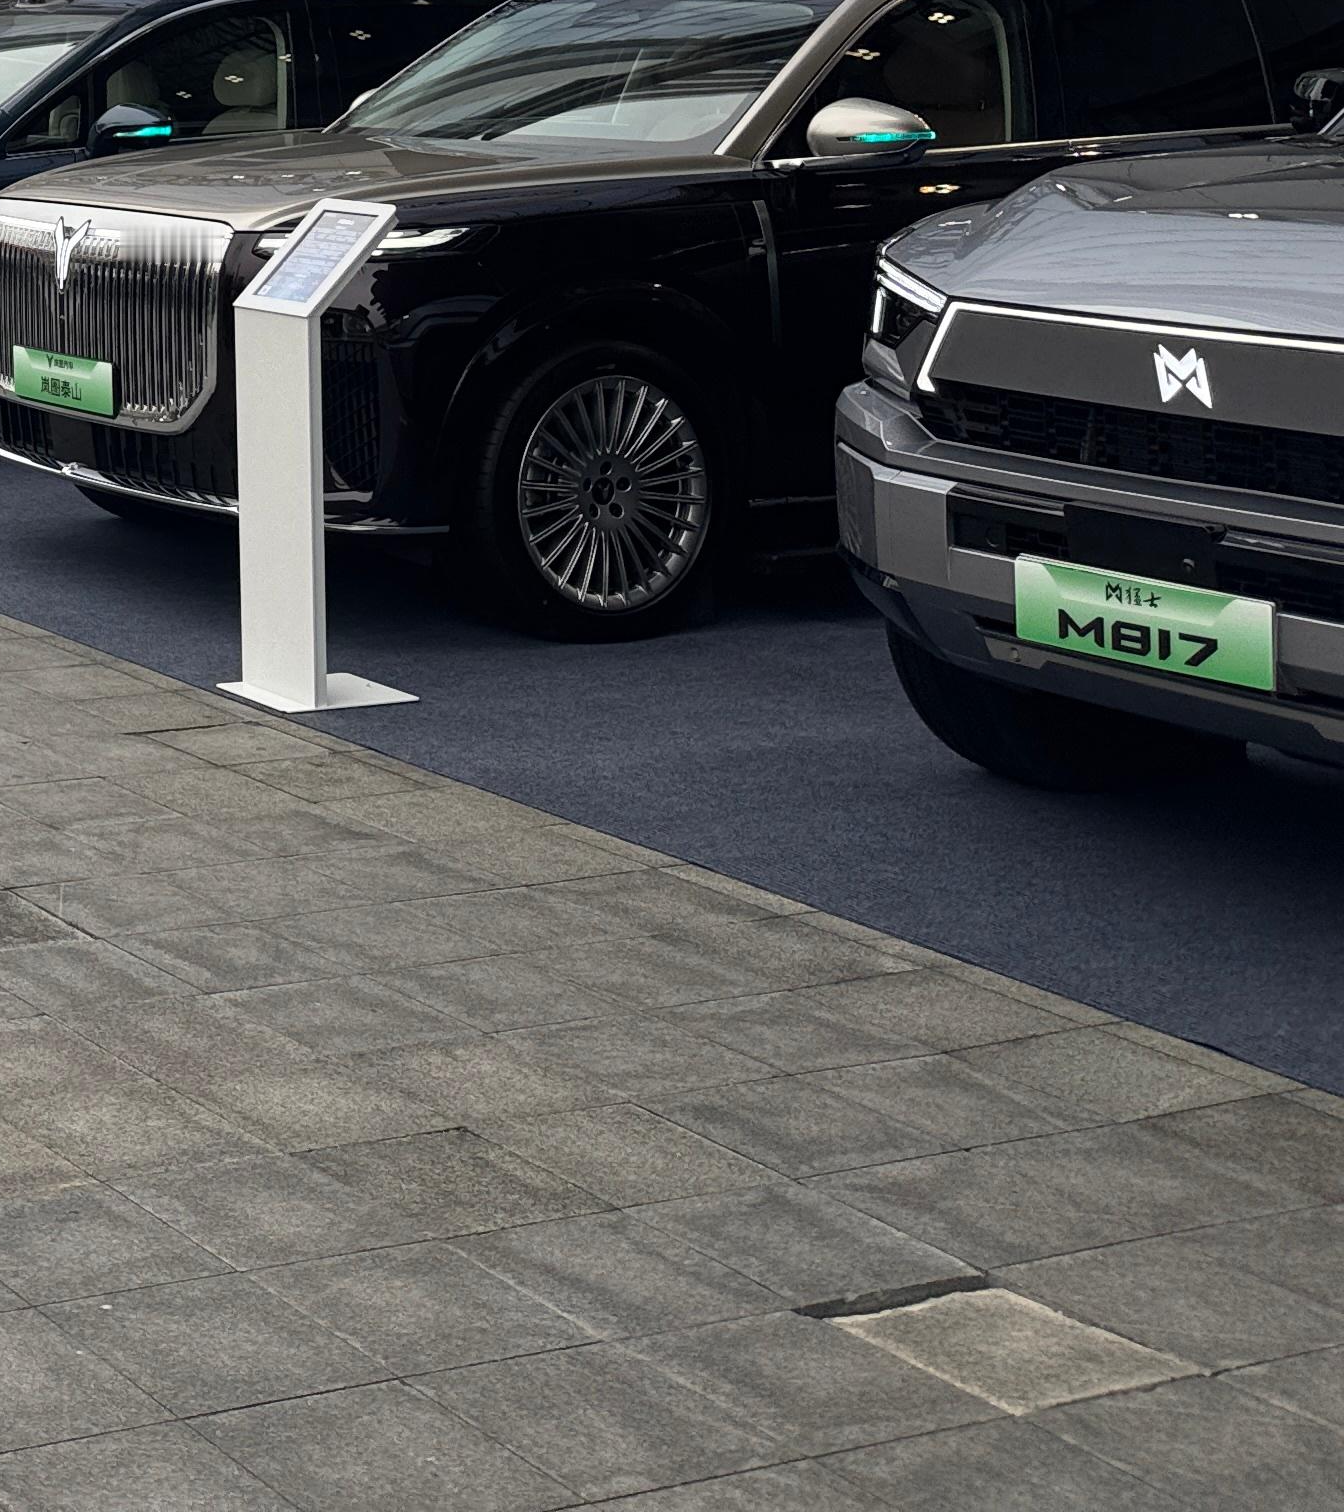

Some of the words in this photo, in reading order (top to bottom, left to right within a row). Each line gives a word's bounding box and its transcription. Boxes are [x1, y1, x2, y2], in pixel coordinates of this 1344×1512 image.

[40, 375, 82, 401] 岚图泰山
[1125, 586, 1162, 609] 猛士
[1057, 608, 1218, 667] M817
